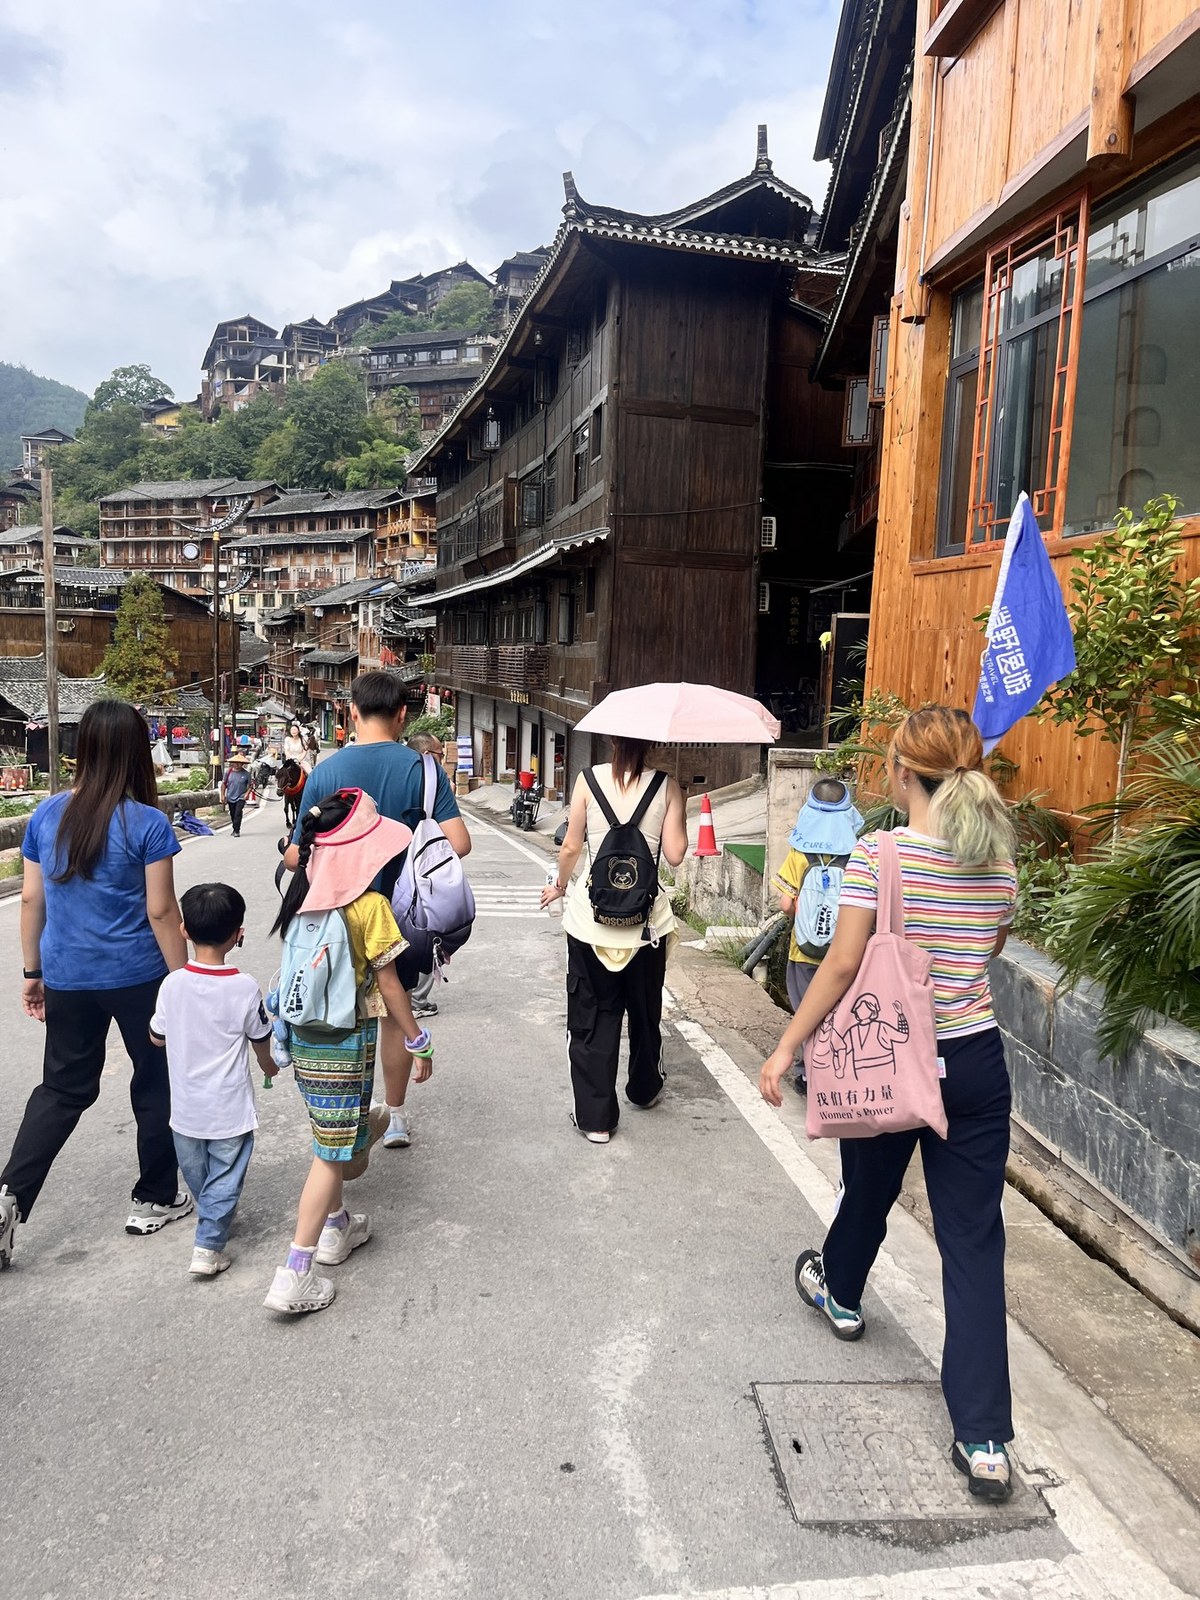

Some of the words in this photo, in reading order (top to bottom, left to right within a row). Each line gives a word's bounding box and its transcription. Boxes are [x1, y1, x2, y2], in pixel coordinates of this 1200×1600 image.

[598, 913, 642, 926] MOSCHINO
[816, 1084, 894, 1107] 我们有力量
[863, 1106, 895, 1117] Power
